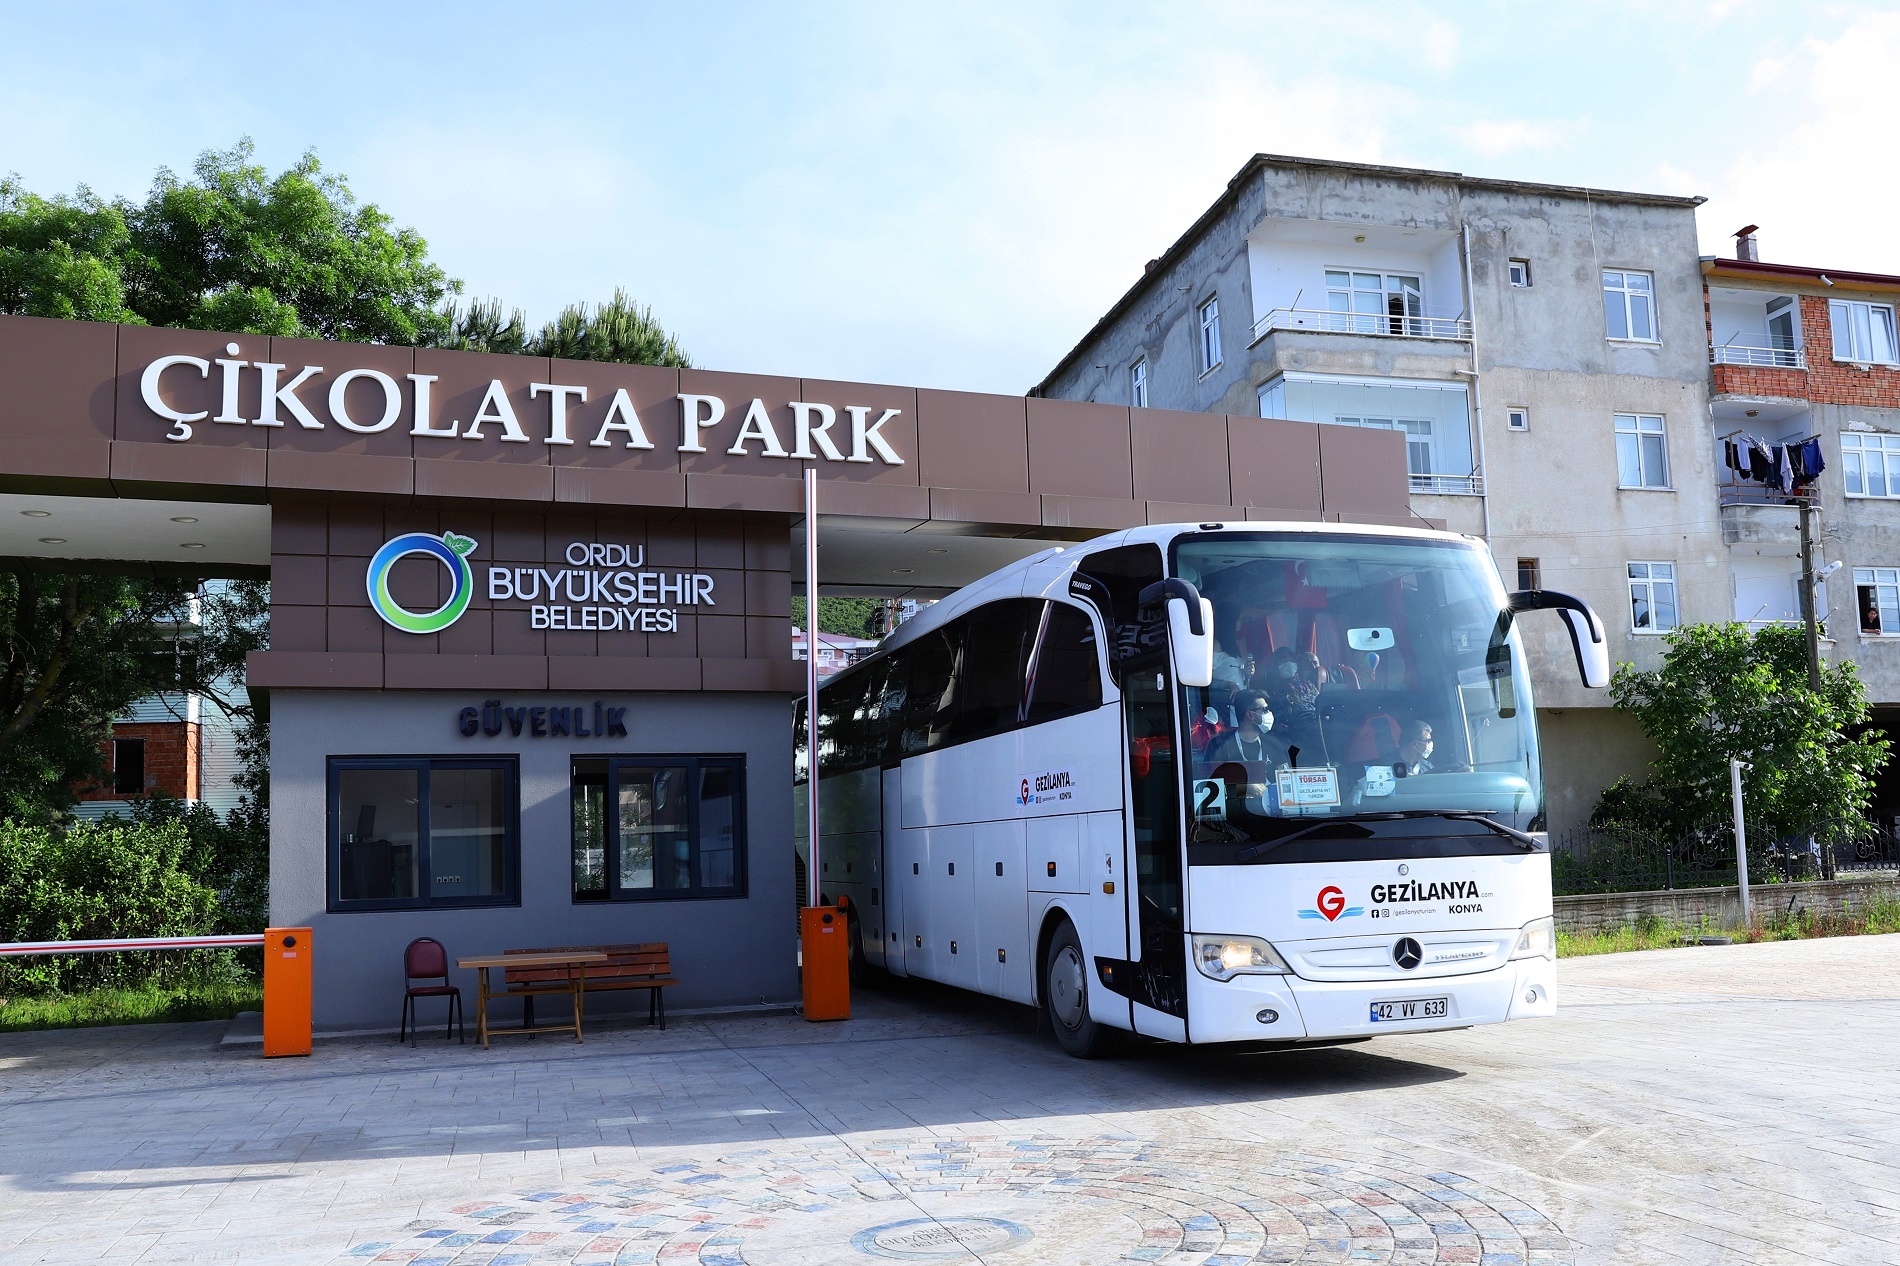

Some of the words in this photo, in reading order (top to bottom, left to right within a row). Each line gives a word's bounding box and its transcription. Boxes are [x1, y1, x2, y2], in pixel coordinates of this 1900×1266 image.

[140, 342, 655, 450] ÇİKOLATA
[677, 393, 905, 465] PARK
[565, 542, 644, 568] ORDU
[488, 567, 716, 606] BÜYÜKŞEHİR
[1071, 580, 1092, 591] TRAVEGO
[530, 604, 678, 633] BELEDİYESİ
[459, 700, 628, 737] GÜVENLİK
[1298, 774, 1328, 783] TÜRSAB
[1194, 780, 1222, 816] 2
[1448, 903, 1483, 914] KONYA
[1379, 1004, 1393, 1019] 42
[1402, 1002, 1416, 1017] VV
[1424, 1000, 1445, 1015] 633
